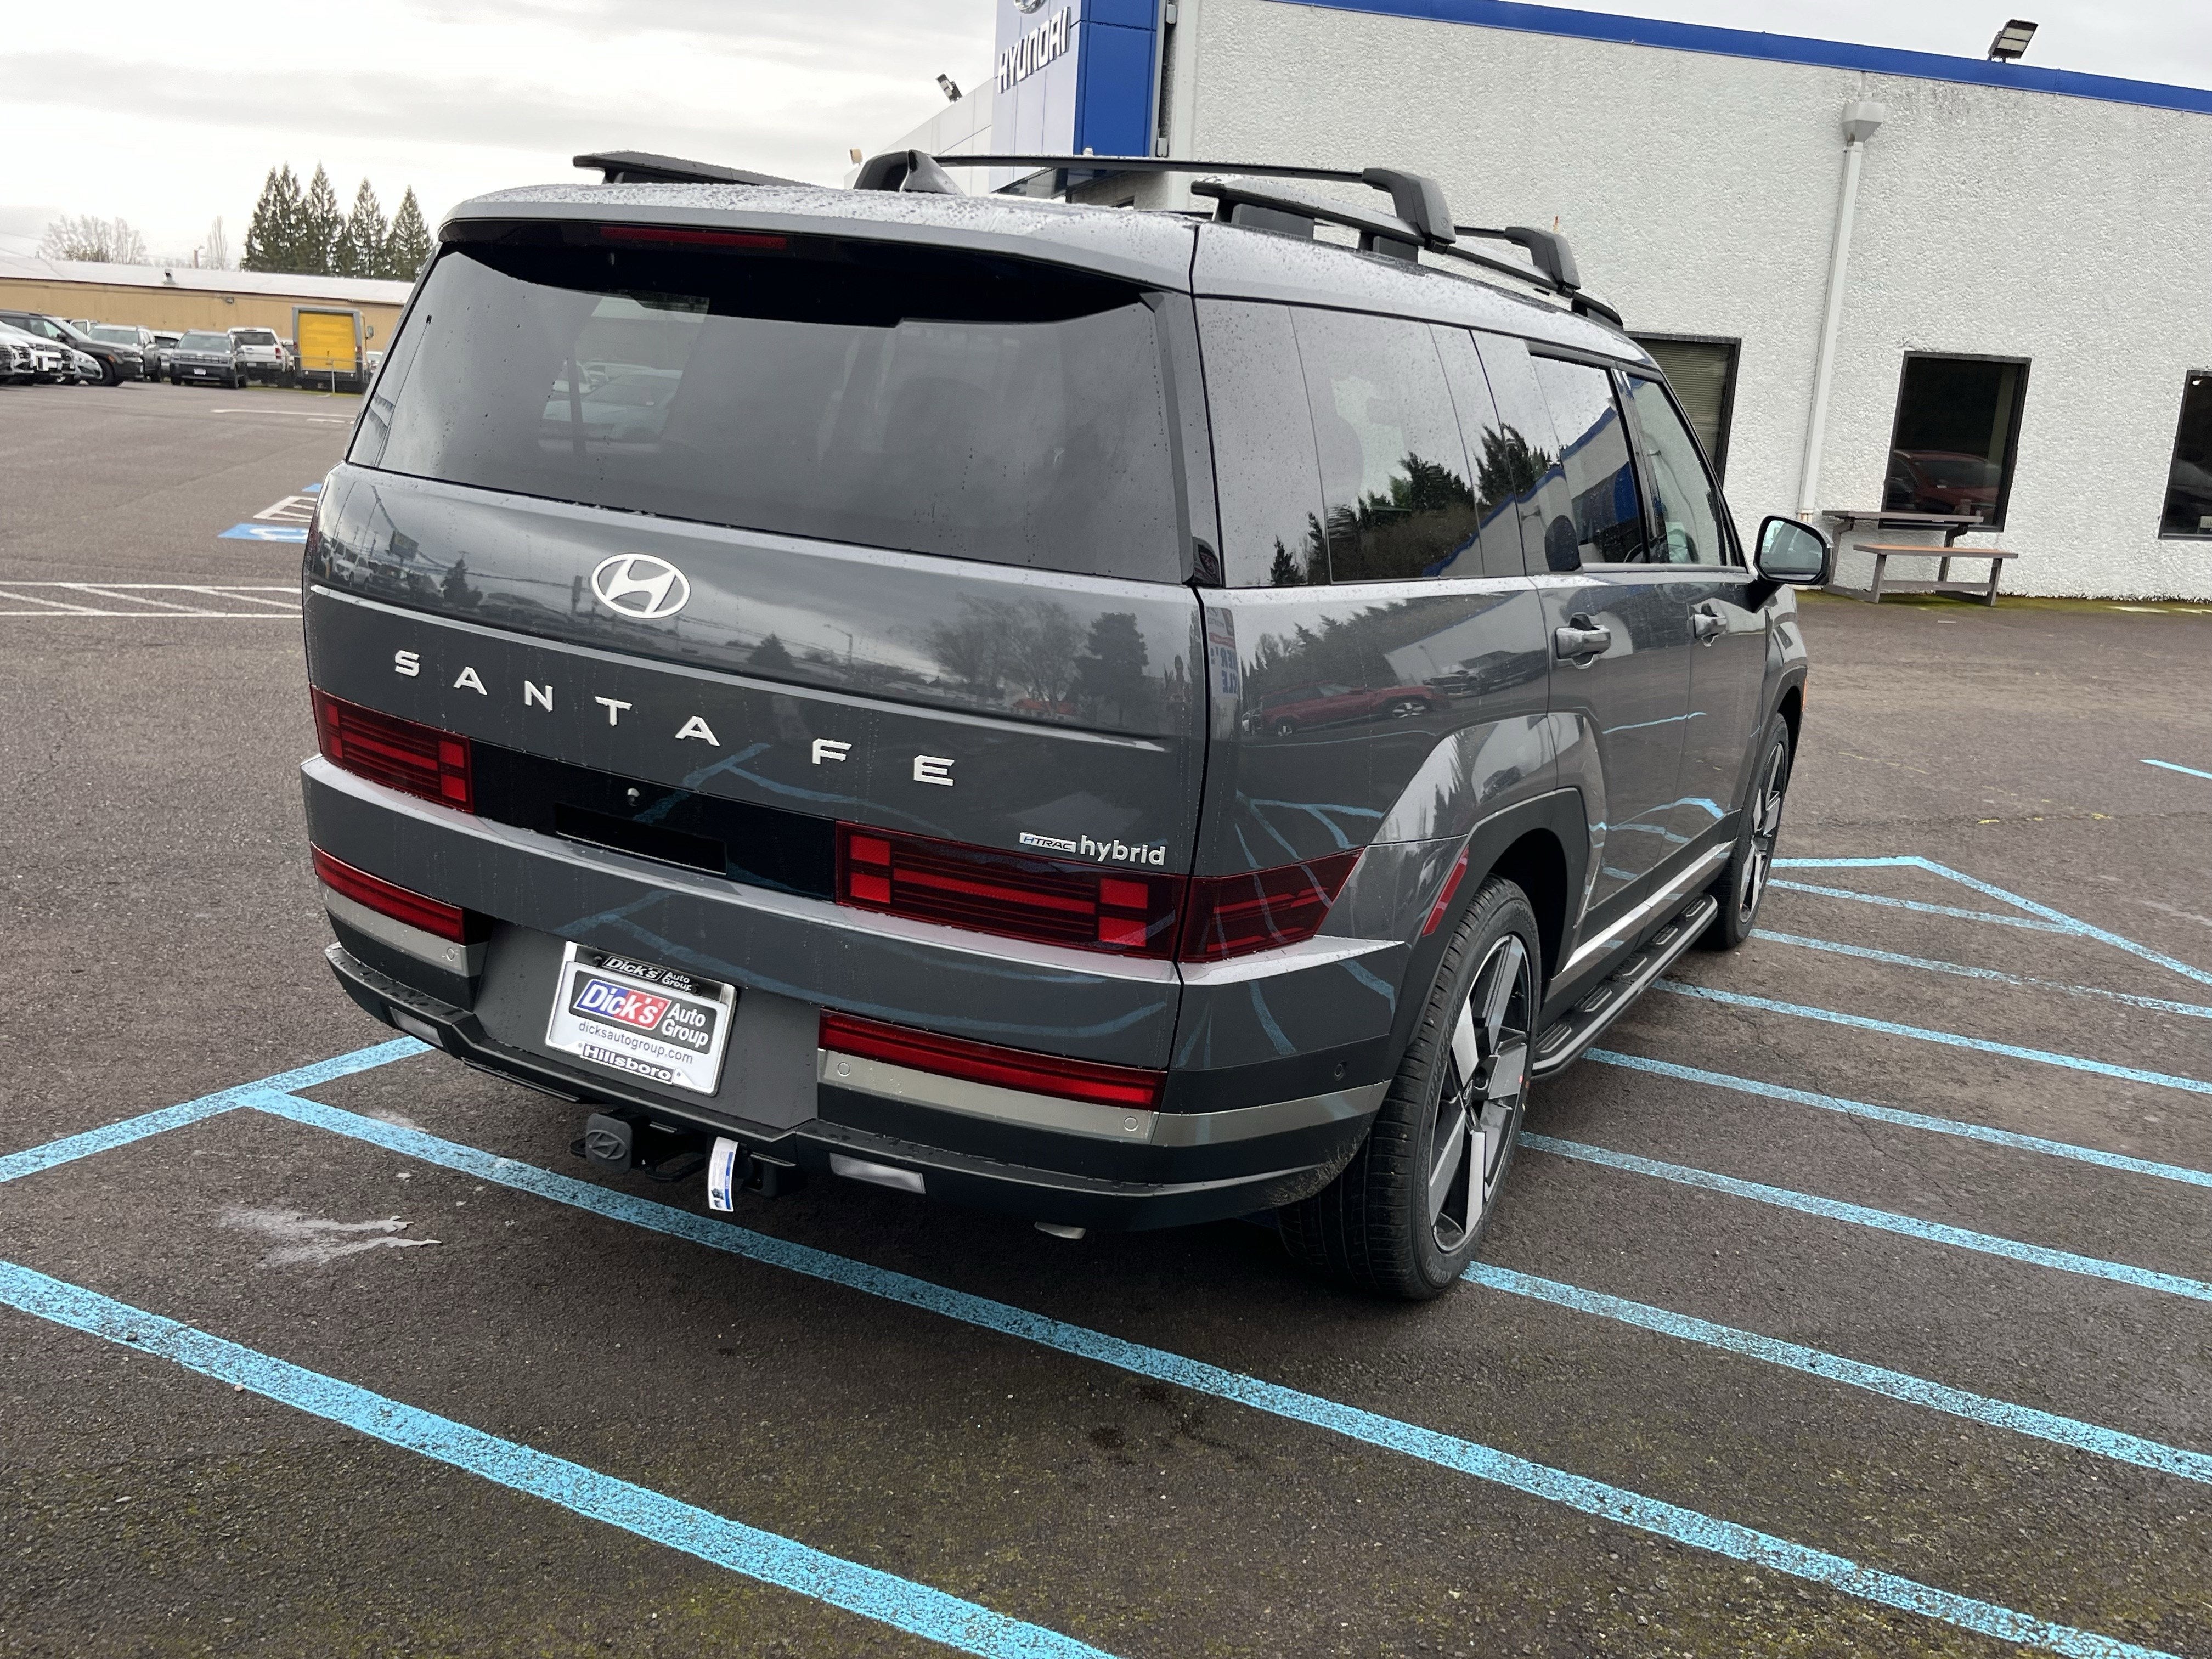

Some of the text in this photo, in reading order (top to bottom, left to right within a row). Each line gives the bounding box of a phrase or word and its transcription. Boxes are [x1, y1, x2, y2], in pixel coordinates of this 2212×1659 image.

[997, 6, 1072, 94] HYUNDAI
[394, 650, 955, 786] SANTA FE
[1023, 834, 1166, 866] HTRAC hybrid
[664, 972, 690, 984] Auto
[667, 1003, 707, 1028] Auto
[579, 1021, 693, 1064] dicksautogroup.com
[661, 1022, 709, 1048] Group
[583, 1045, 672, 1081] Hillsboro
